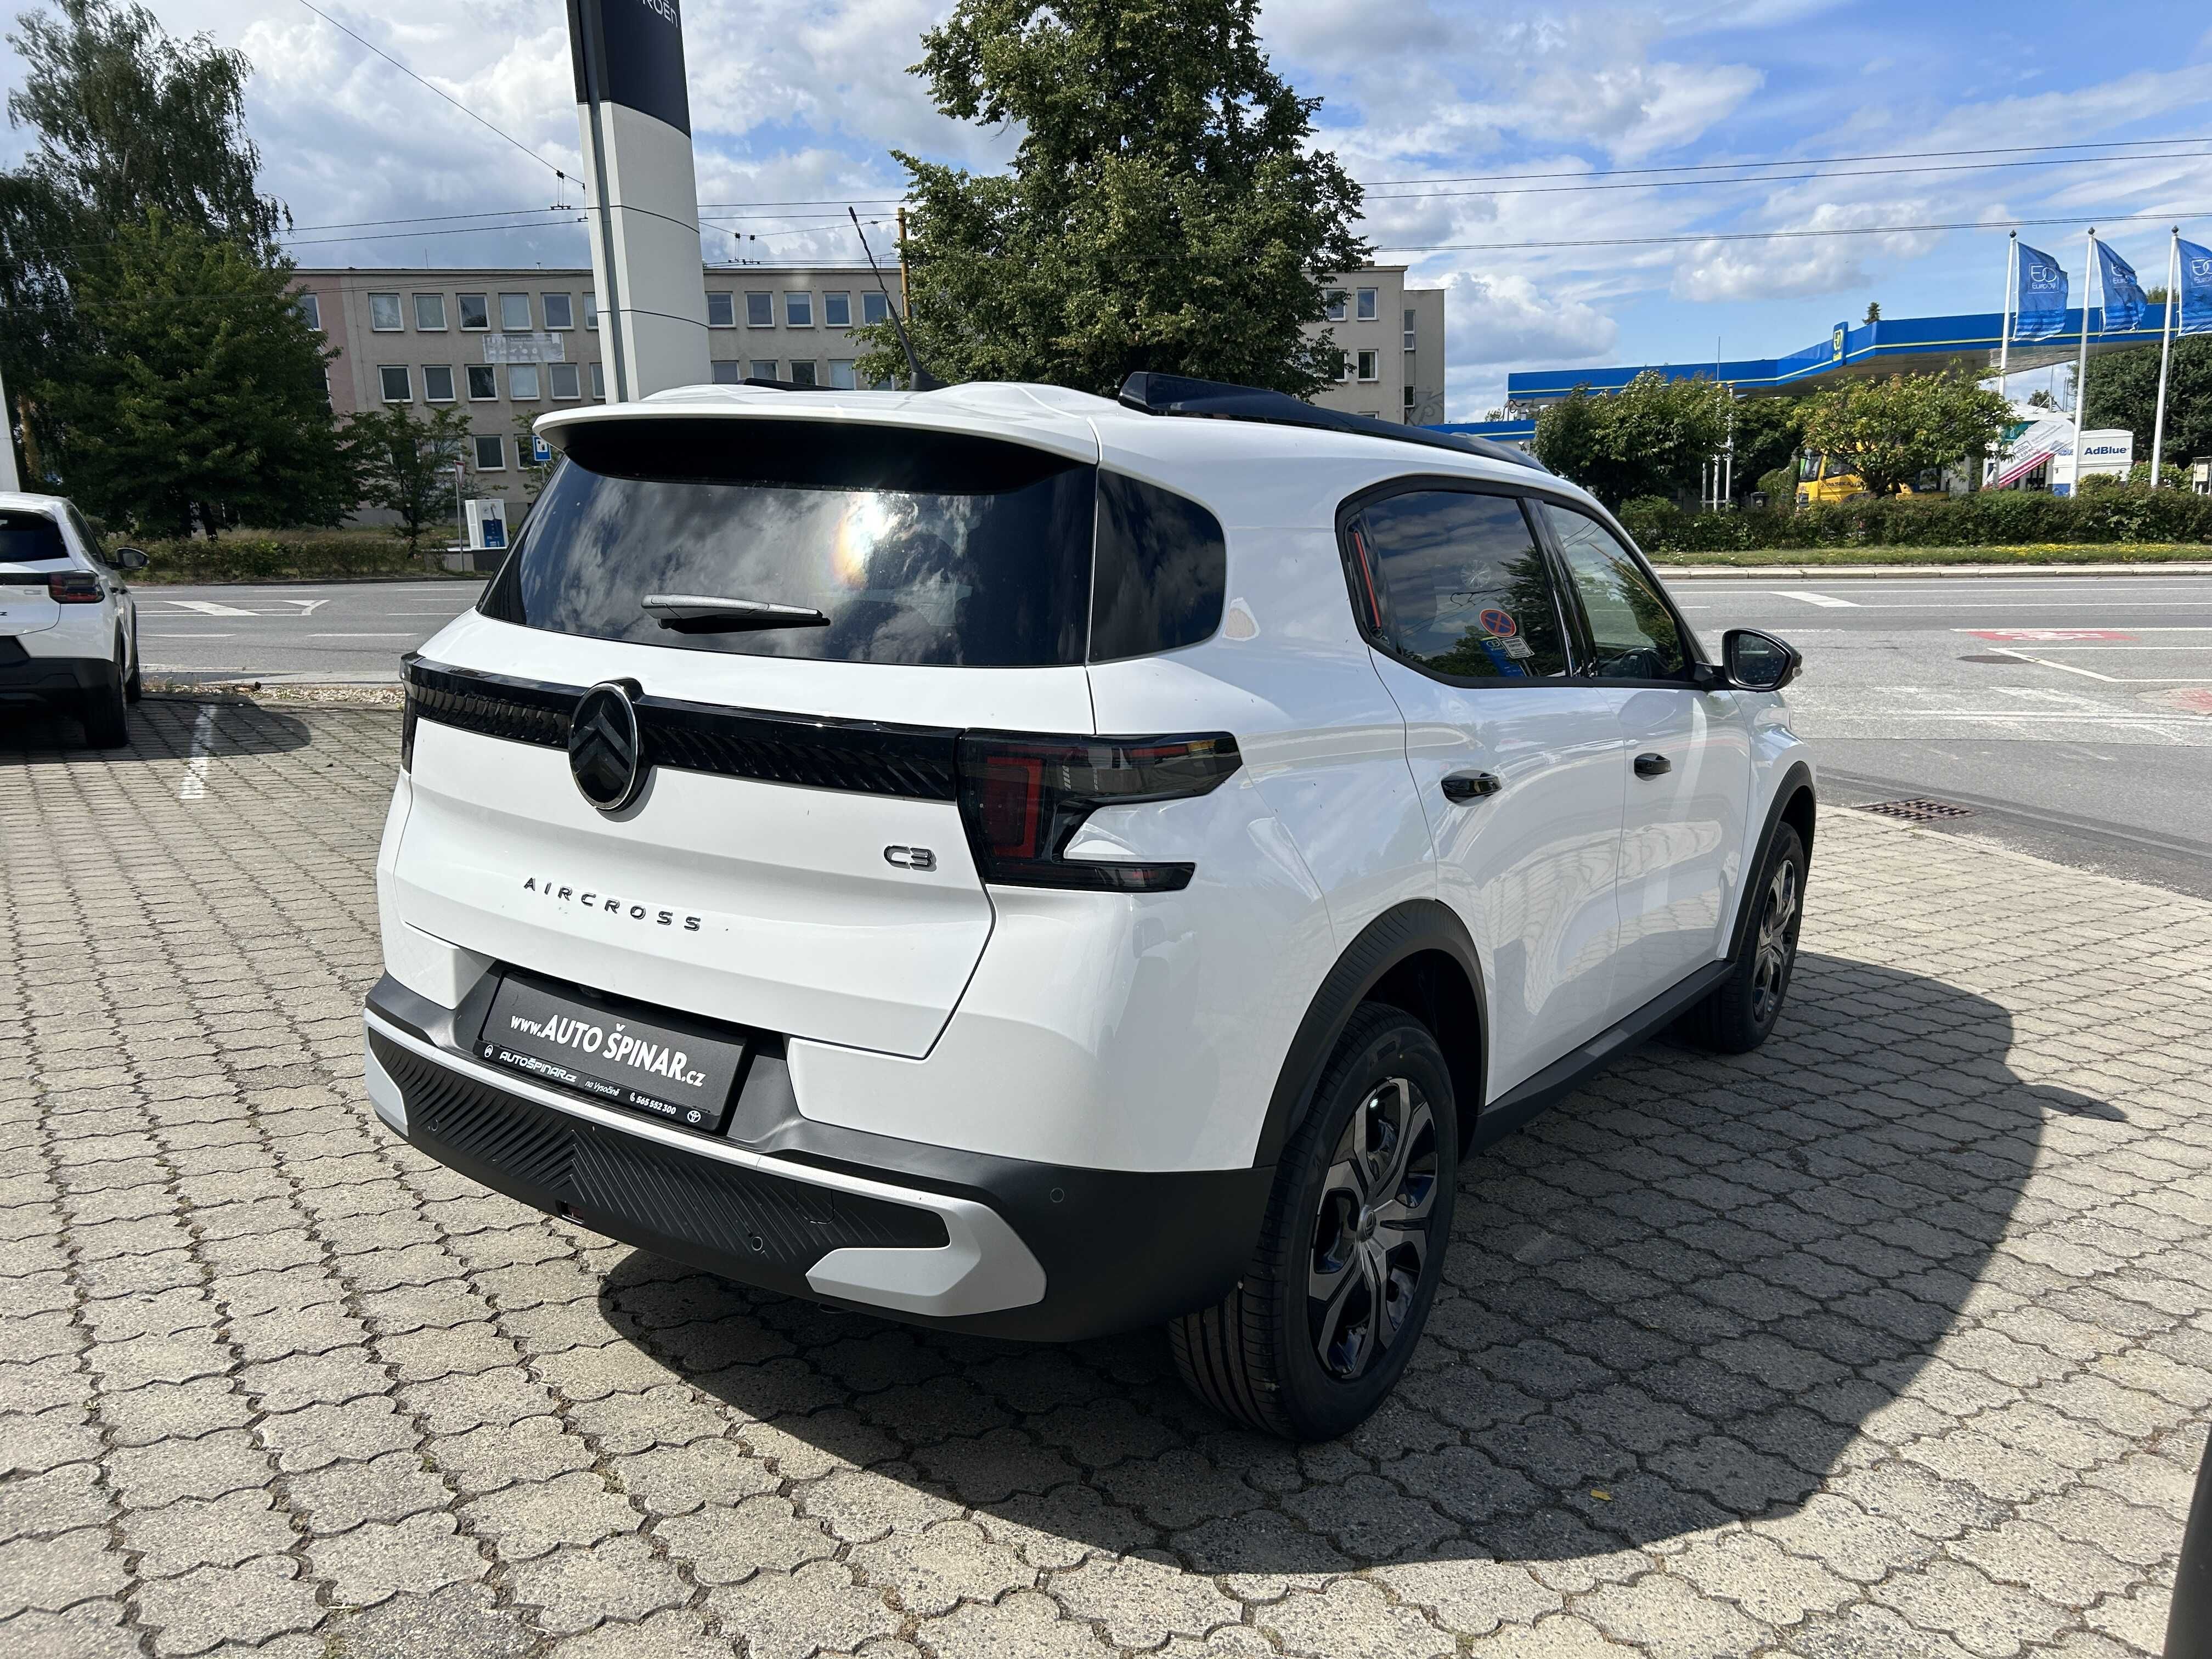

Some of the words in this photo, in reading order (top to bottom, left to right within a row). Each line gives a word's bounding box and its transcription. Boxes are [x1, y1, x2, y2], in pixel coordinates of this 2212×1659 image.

[2084, 446, 2127, 455] AdBlue
[883, 845, 935, 871] C3
[523, 877, 701, 932] AIRCROSS
[510, 1014, 603, 1053] www.AUTO
[602, 1023, 707, 1087] ŠPINAR.cz
[499, 1051, 577, 1083] AUTOŠPINAR.cz
[594, 1082, 620, 1096] Vysočině
[636, 1096, 650, 1106] 565
[649, 1100, 662, 1110] 552
[662, 1104, 676, 1115] 300
